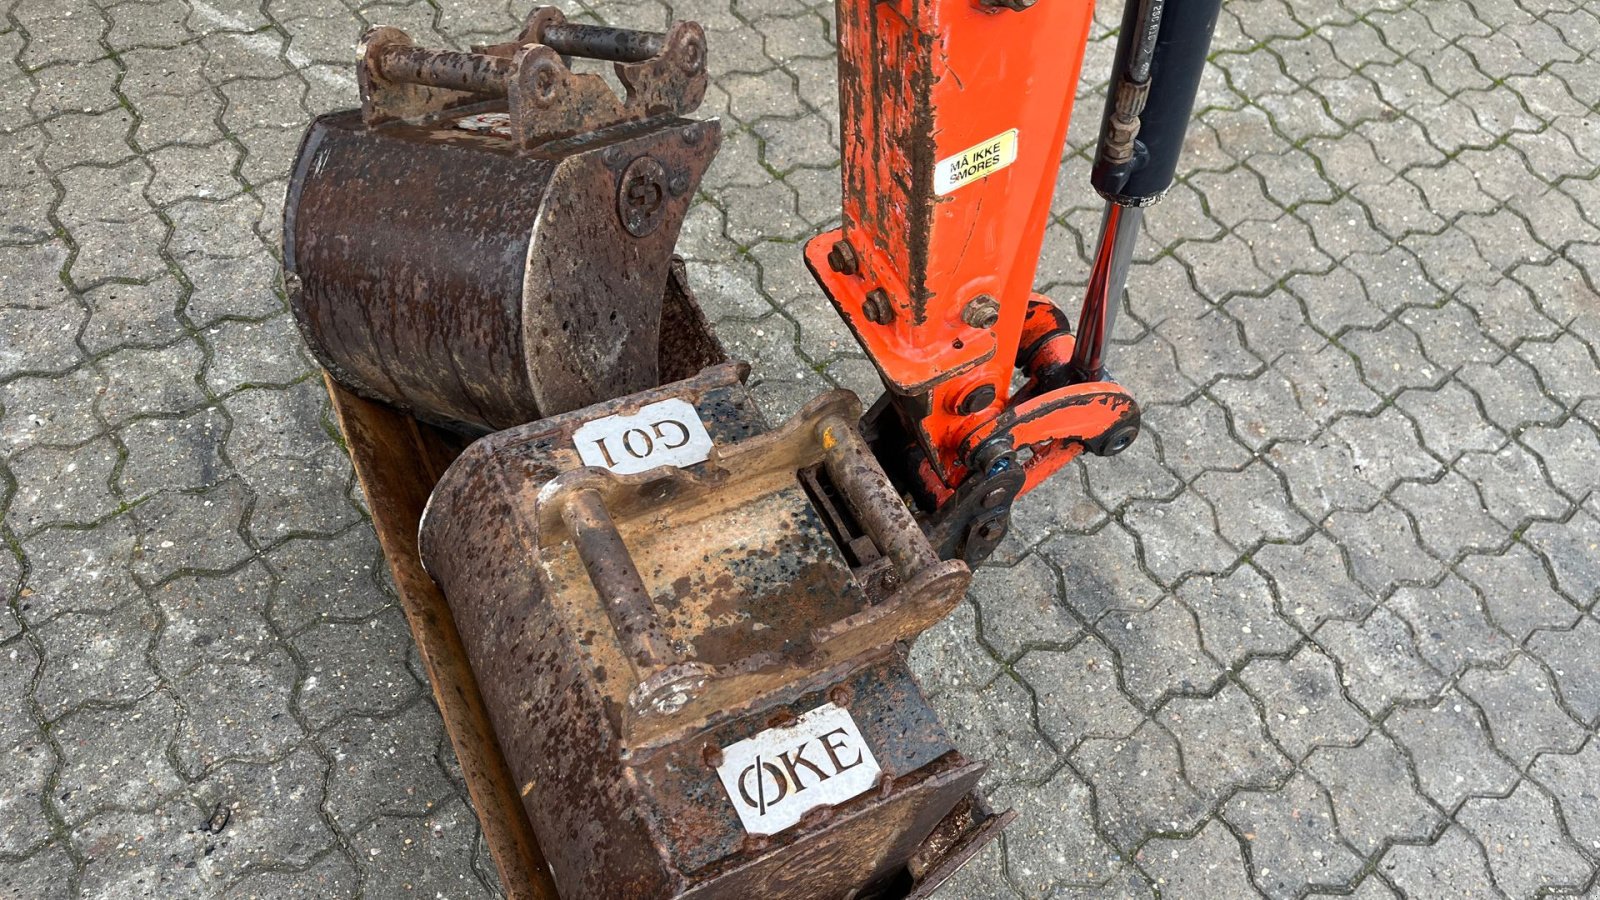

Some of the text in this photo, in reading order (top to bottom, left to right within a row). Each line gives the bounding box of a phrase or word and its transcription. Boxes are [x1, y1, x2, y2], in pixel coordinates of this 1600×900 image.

[950, 142, 1000, 173] MÅ IKKE
[738, 727, 863, 816] ØKE
